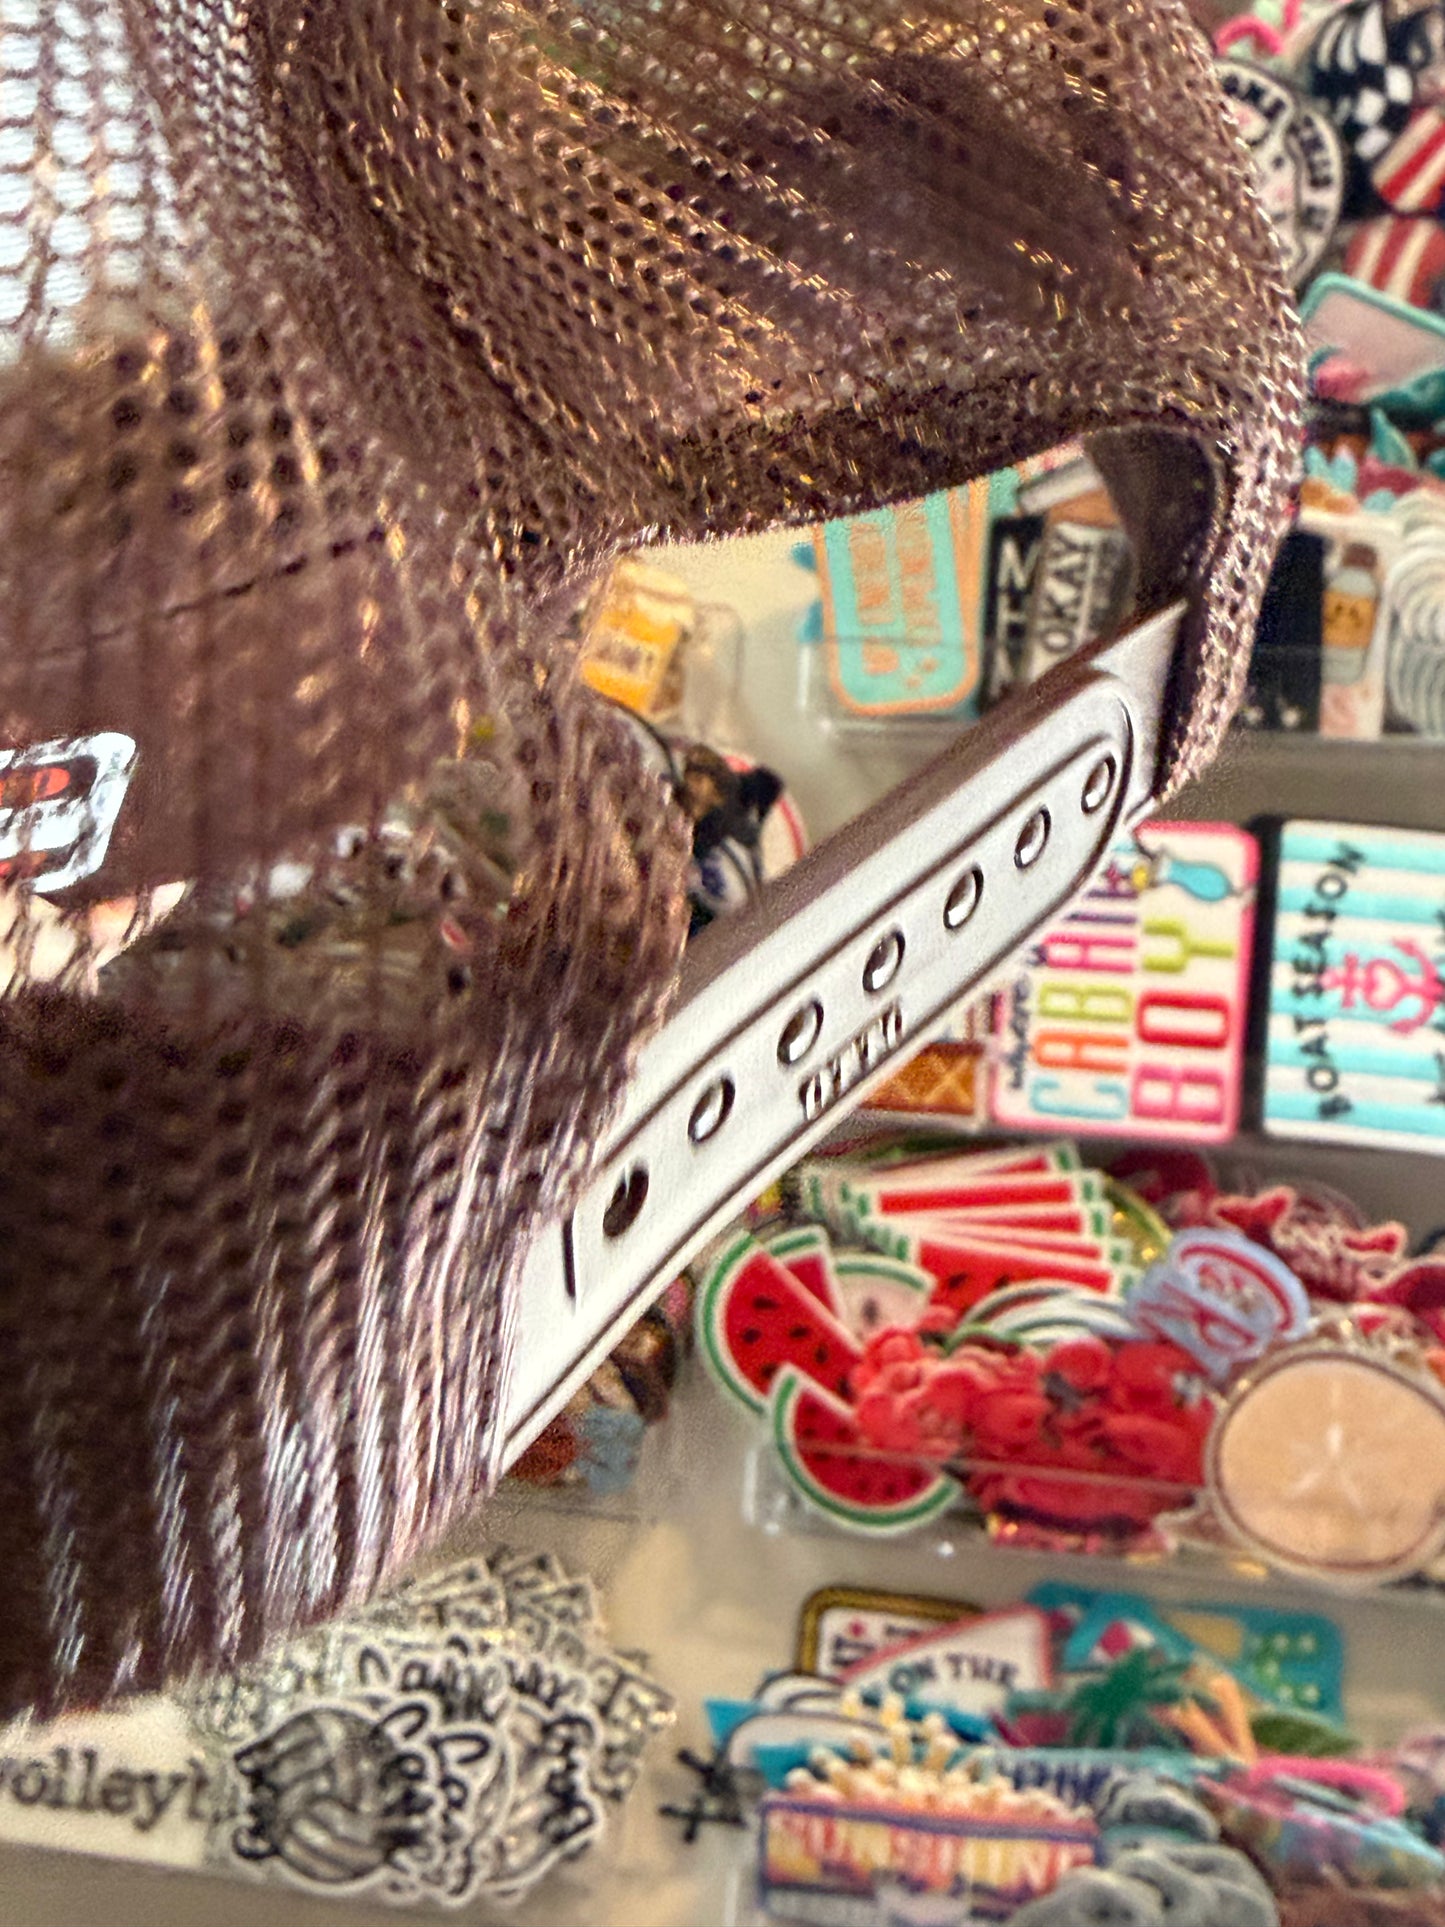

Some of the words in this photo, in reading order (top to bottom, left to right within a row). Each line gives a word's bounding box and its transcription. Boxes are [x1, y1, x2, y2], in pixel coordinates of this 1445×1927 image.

[1042, 530, 1091, 653] OKAY
[1293, 841, 1366, 999] SEASON
[1130, 917, 1235, 1125] BOY
[1294, 1012, 1353, 1121] BOAT
